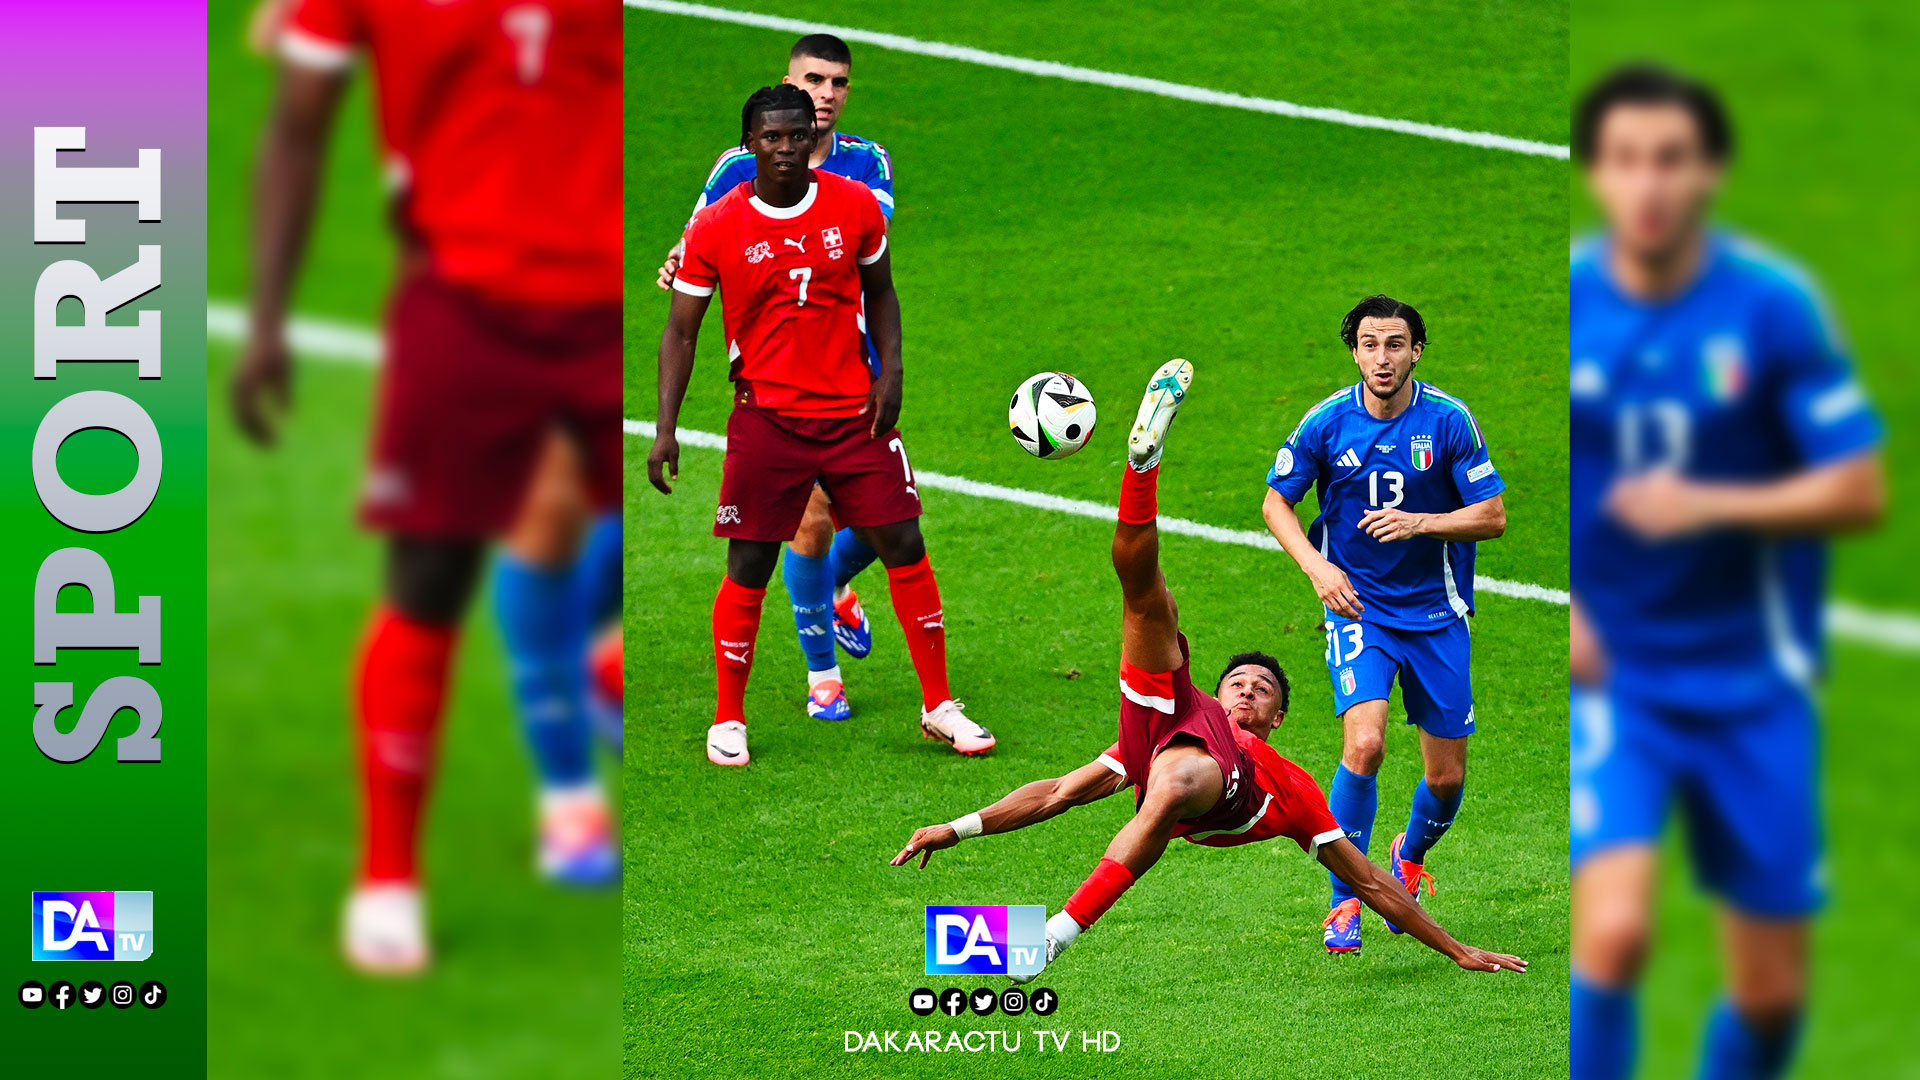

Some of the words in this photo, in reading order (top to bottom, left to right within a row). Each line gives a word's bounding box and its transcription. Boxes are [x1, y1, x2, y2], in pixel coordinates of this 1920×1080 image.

[789, 266, 812, 307] 7
[888, 437, 911, 483] 7
[1369, 470, 1404, 508] 13
[1333, 623, 1364, 668] 13
